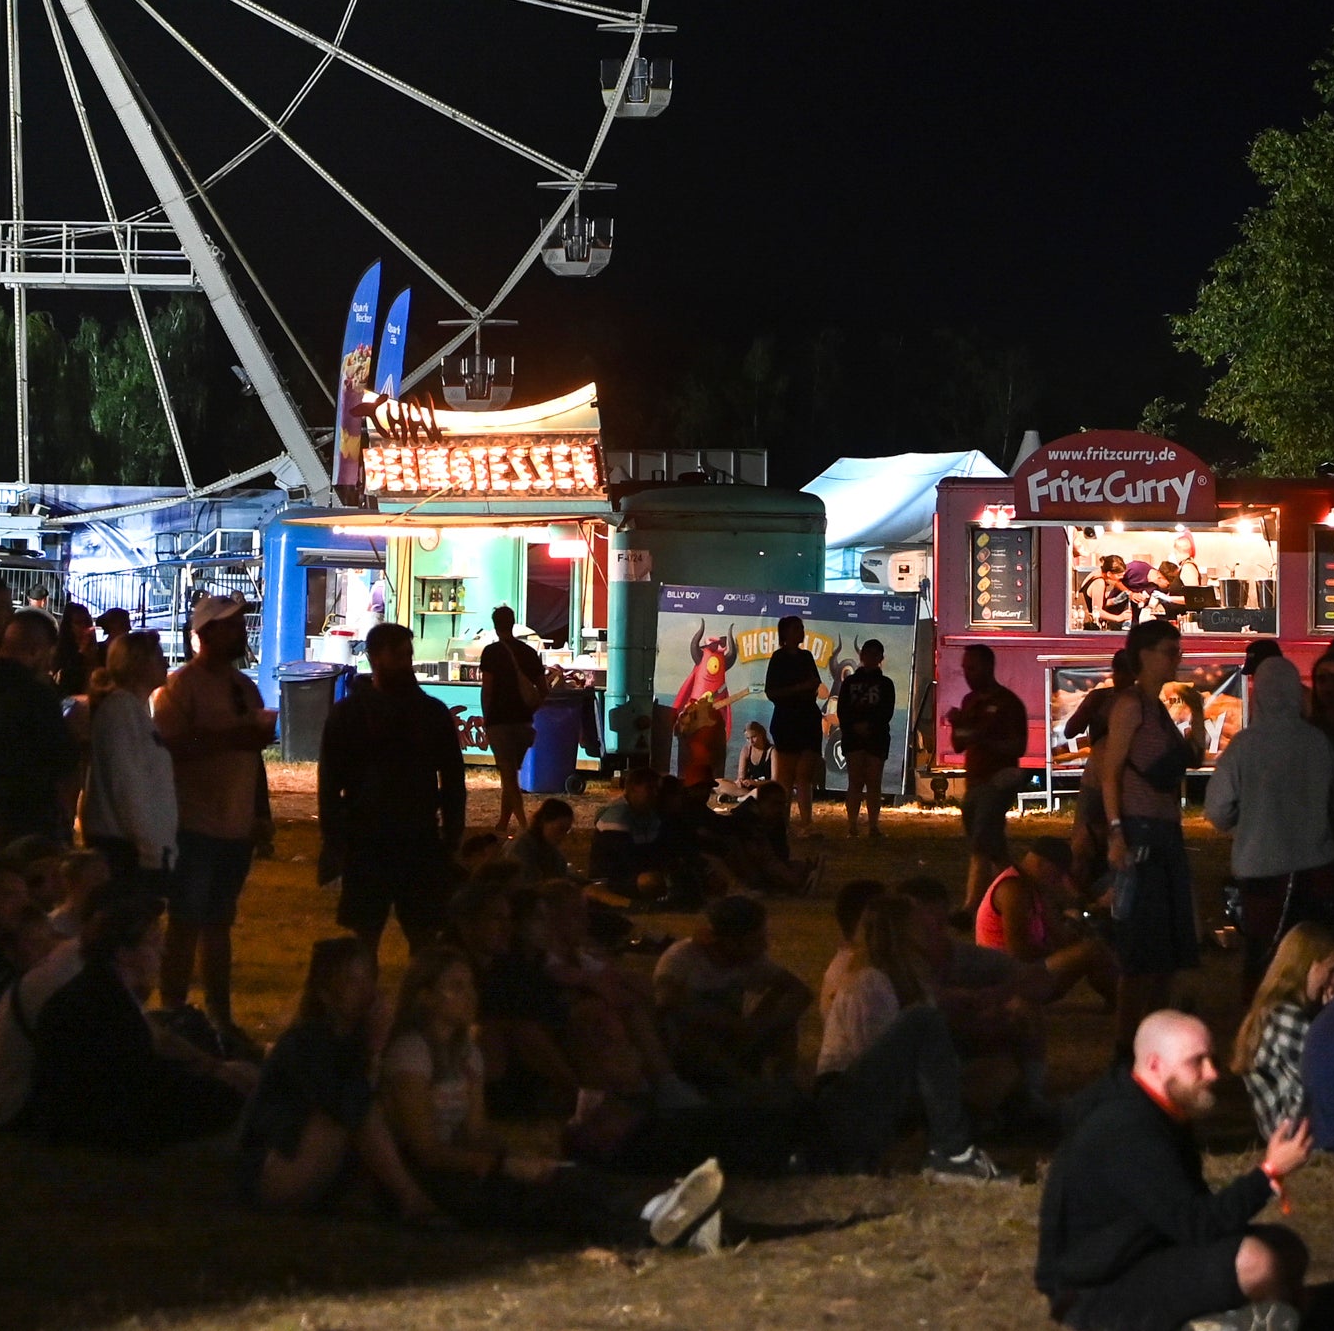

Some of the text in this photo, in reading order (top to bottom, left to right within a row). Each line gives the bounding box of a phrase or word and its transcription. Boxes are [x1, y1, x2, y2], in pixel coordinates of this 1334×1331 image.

[349, 390, 443, 446] THAI
[1048, 446, 1177, 465] www.fritzcurry.de
[667, 590, 701, 600] BILLY BOY
